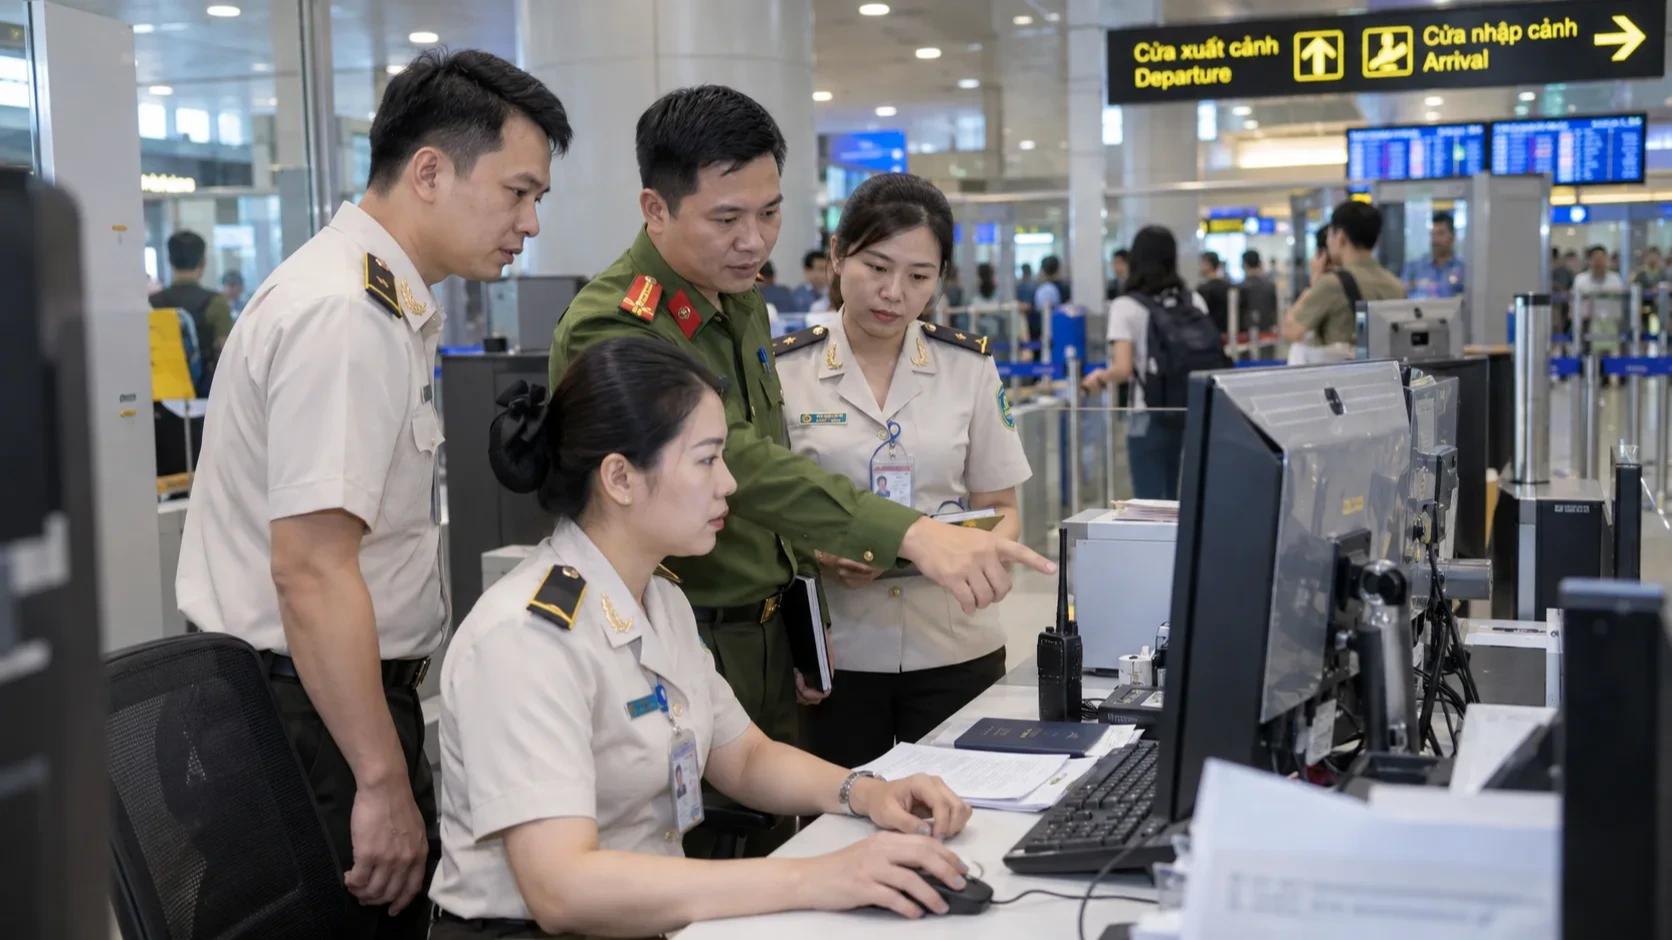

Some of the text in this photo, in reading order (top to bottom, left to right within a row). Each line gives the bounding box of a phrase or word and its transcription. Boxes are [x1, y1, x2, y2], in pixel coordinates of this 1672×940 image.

[1422, 17, 1578, 47] Cửa nhập cảnh
[1133, 35, 1279, 63] Cửa xuất cảnh
[1422, 48, 1489, 73] Arrival
[1134, 65, 1232, 91] Departure
